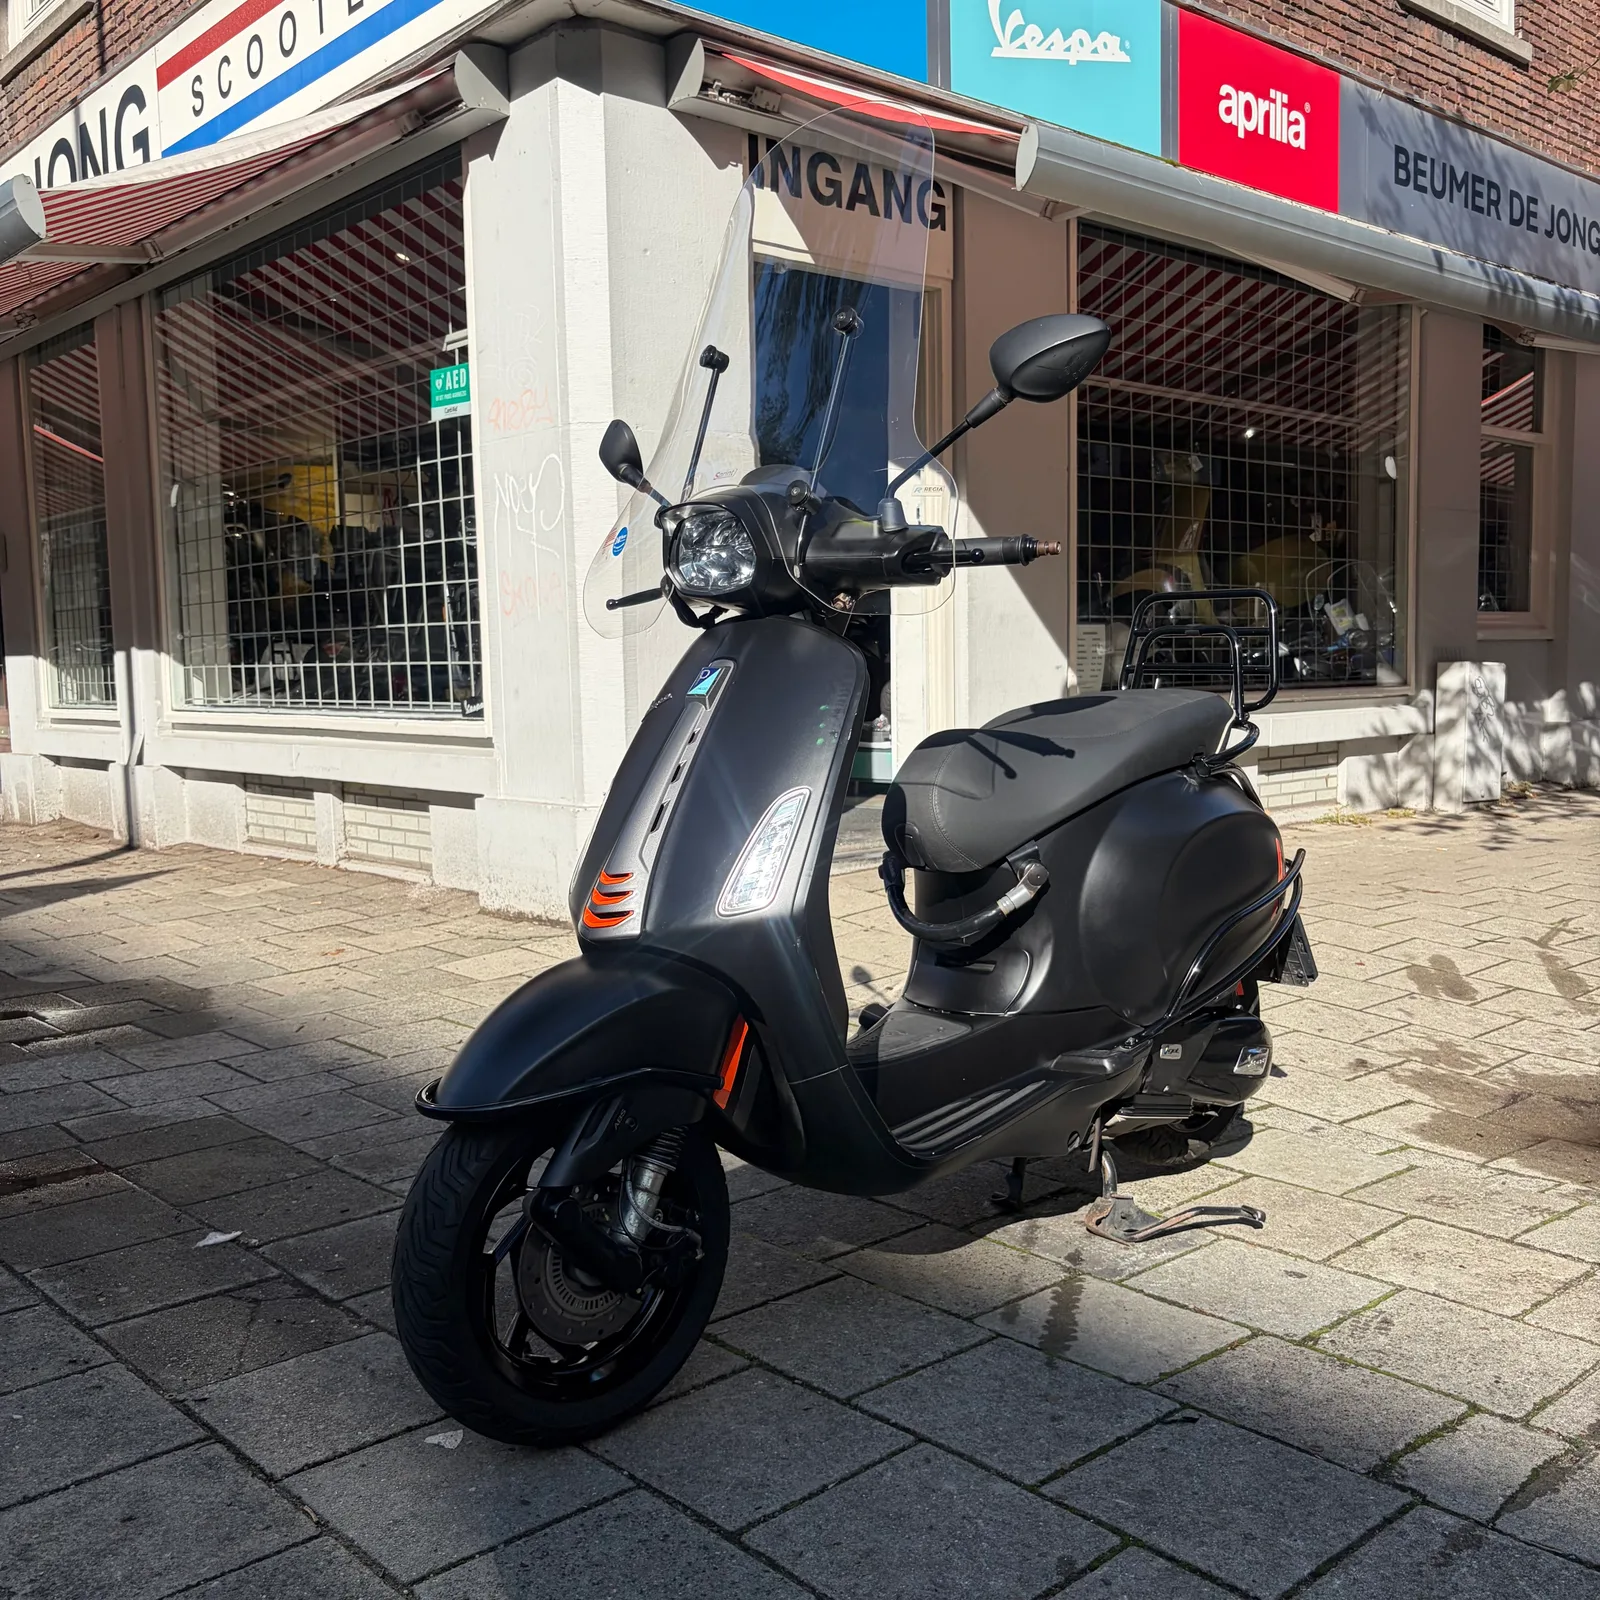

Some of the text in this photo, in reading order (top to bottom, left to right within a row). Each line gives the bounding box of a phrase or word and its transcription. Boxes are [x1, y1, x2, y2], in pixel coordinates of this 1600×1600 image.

[1218, 84, 1306, 151] aprilia
[748, 133, 947, 232] INGANG
[1394, 144, 1600, 256] BEUMER DE JONG
[445, 367, 467, 391] AED
